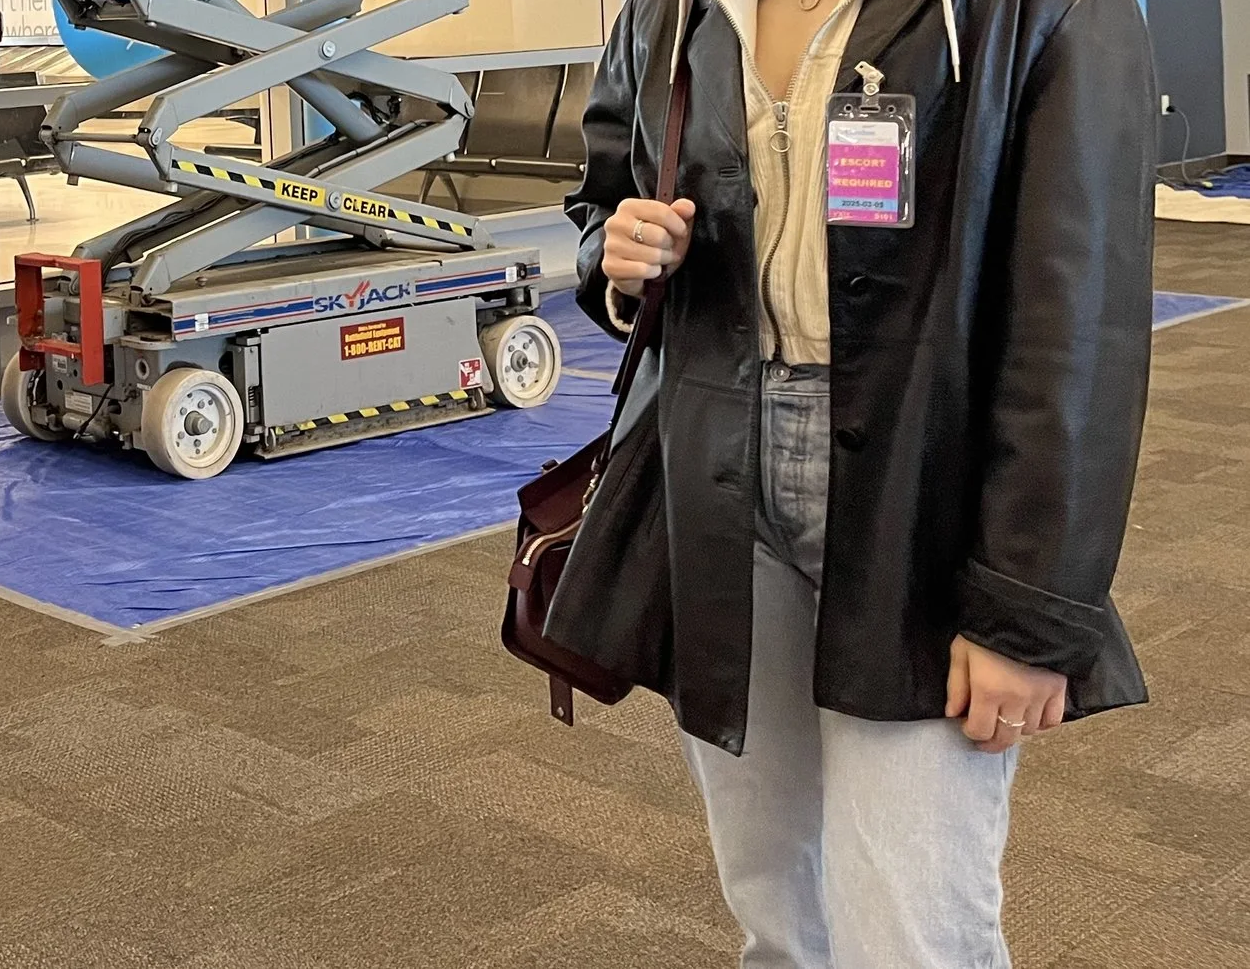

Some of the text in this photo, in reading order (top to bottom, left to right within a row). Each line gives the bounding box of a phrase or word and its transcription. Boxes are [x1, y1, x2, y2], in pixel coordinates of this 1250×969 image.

[841, 158, 886, 168] ESCORT
[833, 177, 893, 189] REQUIRED
[281, 182, 386, 218] KEEP CLEAR
[314, 279, 411, 313] SKYJACK
[344, 336, 402, 357] 1-800-RENT-CAT
